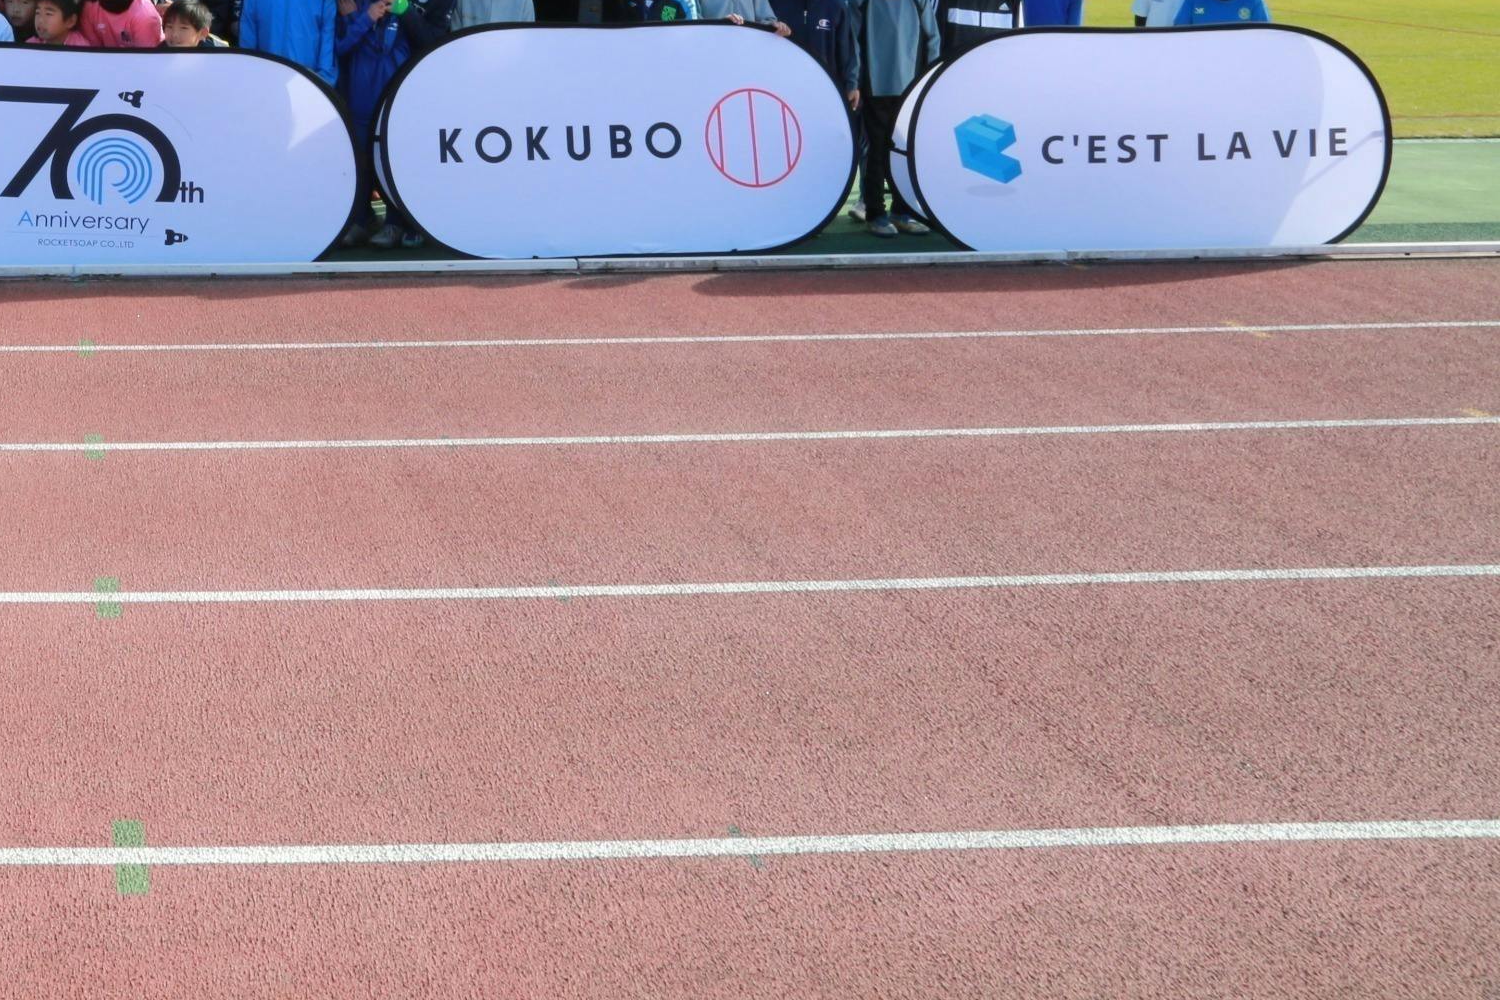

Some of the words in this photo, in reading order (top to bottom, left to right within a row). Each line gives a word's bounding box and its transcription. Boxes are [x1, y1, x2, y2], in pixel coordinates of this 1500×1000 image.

[438, 121, 683, 164] KOKUBO
[1041, 133, 1169, 165] C'EST
[1197, 131, 1252, 161] LA
[1272, 127, 1349, 158] VIE
[18, 210, 150, 234] Anniversary
